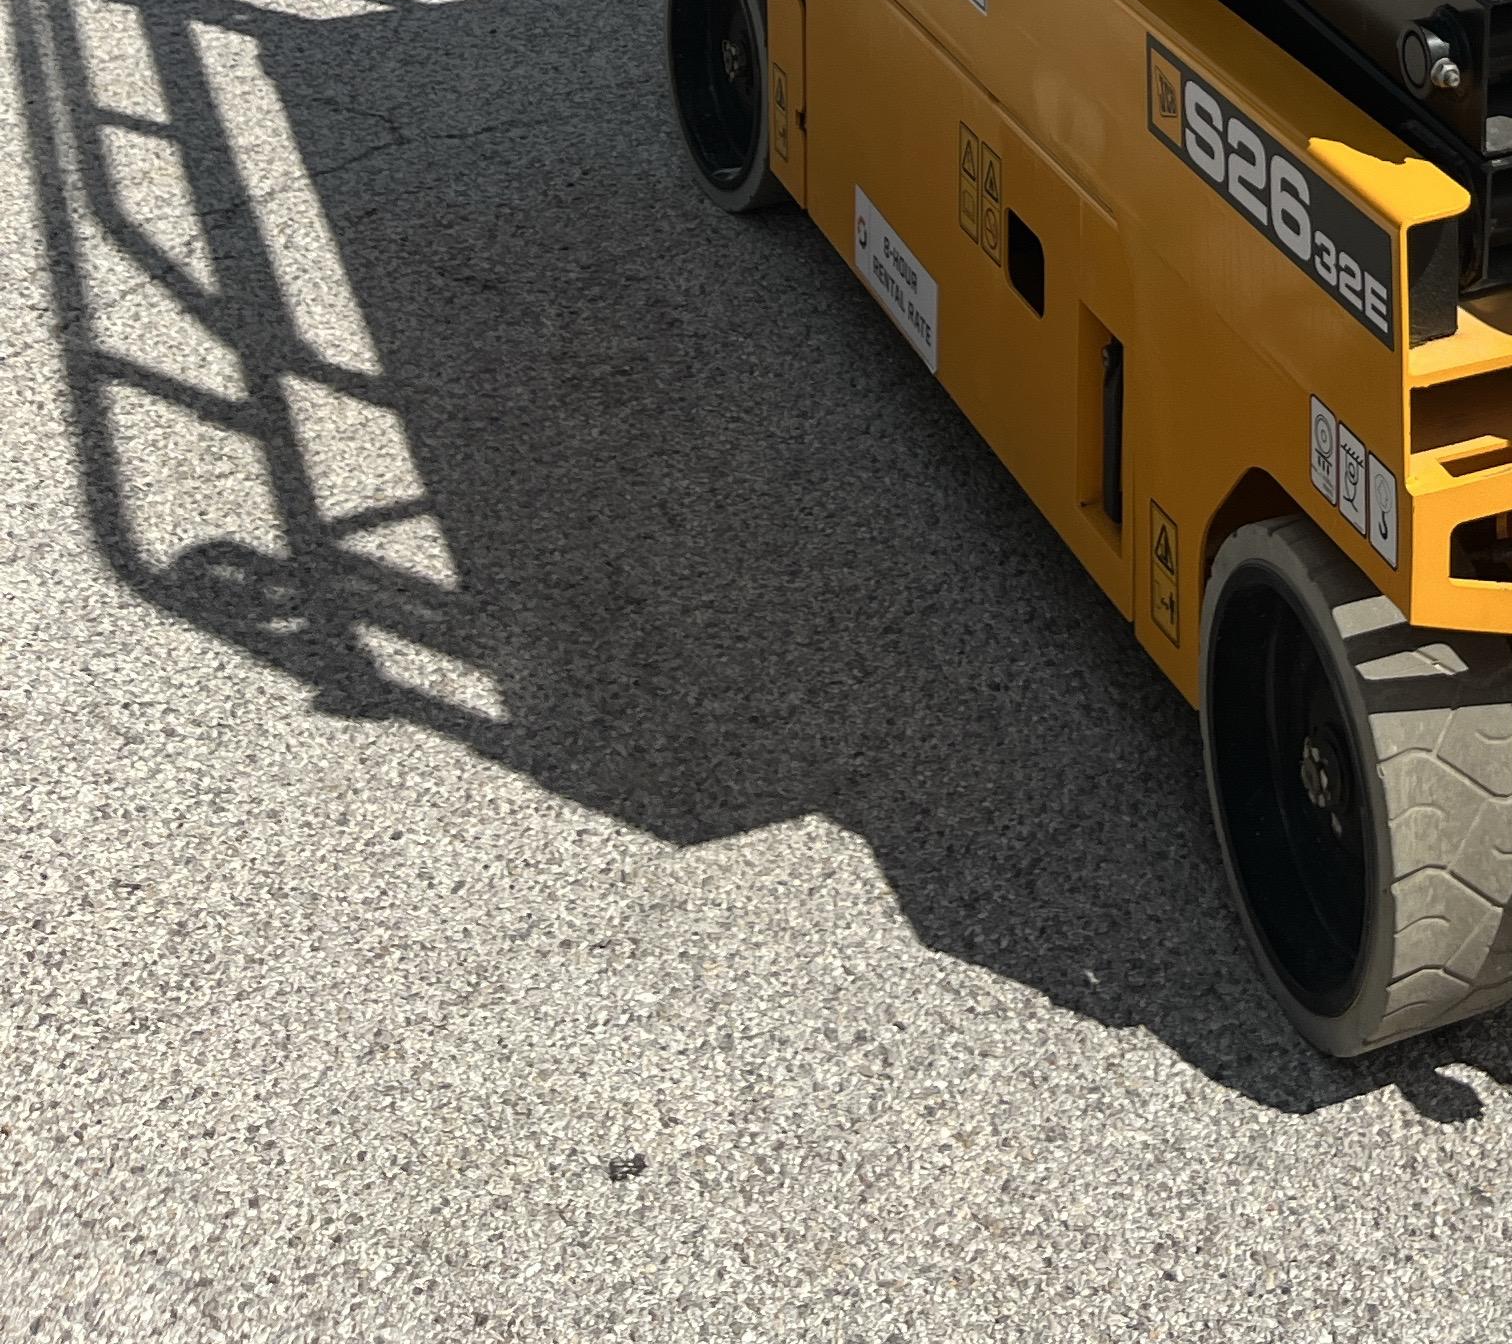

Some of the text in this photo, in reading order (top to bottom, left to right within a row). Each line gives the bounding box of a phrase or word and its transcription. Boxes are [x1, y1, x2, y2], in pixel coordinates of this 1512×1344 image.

[873, 255, 932, 347] RENTAL RATE
[883, 236, 918, 295] 8-HOUR
